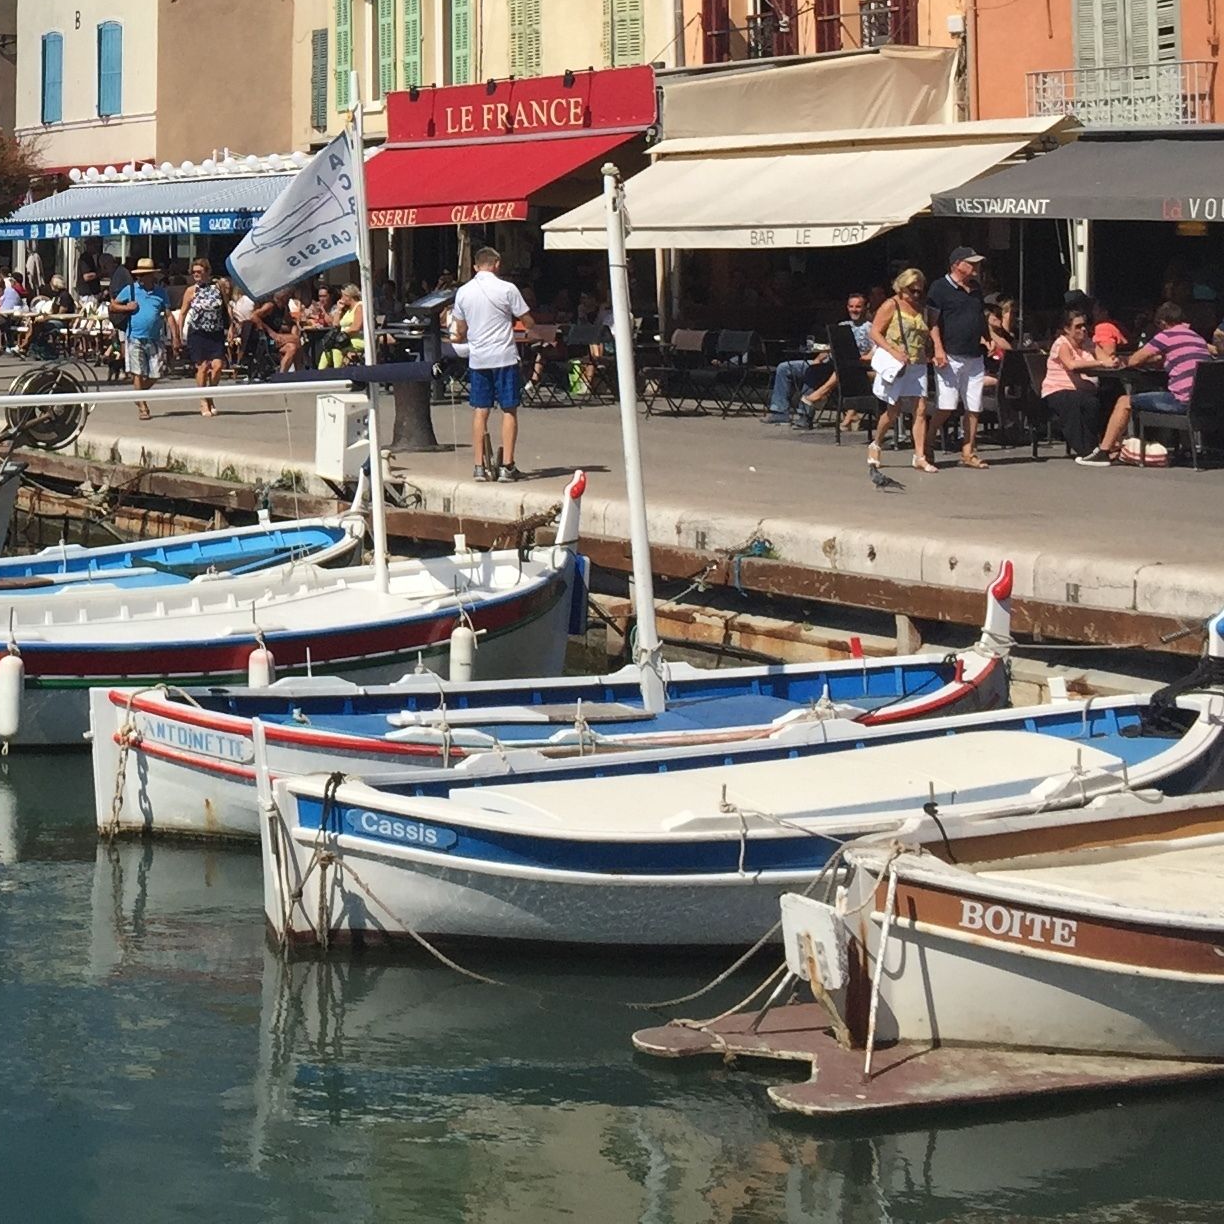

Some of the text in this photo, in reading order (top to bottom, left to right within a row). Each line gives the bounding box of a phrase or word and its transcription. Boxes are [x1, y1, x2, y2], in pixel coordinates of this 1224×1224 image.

[446, 98, 584, 133] LE FRANCE
[370, 202, 514, 226] SSERIE GLACIER
[955, 198, 1051, 214] RESTAURANT
[45, 223, 71, 238] BAR
[80, 221, 100, 236] DE
[110, 219, 129, 234] LA
[139, 217, 200, 234] MARINE
[750, 227, 868, 246] BAR LE PORT
[361, 812, 437, 844] Cassis
[958, 899, 1077, 947] BOITE
